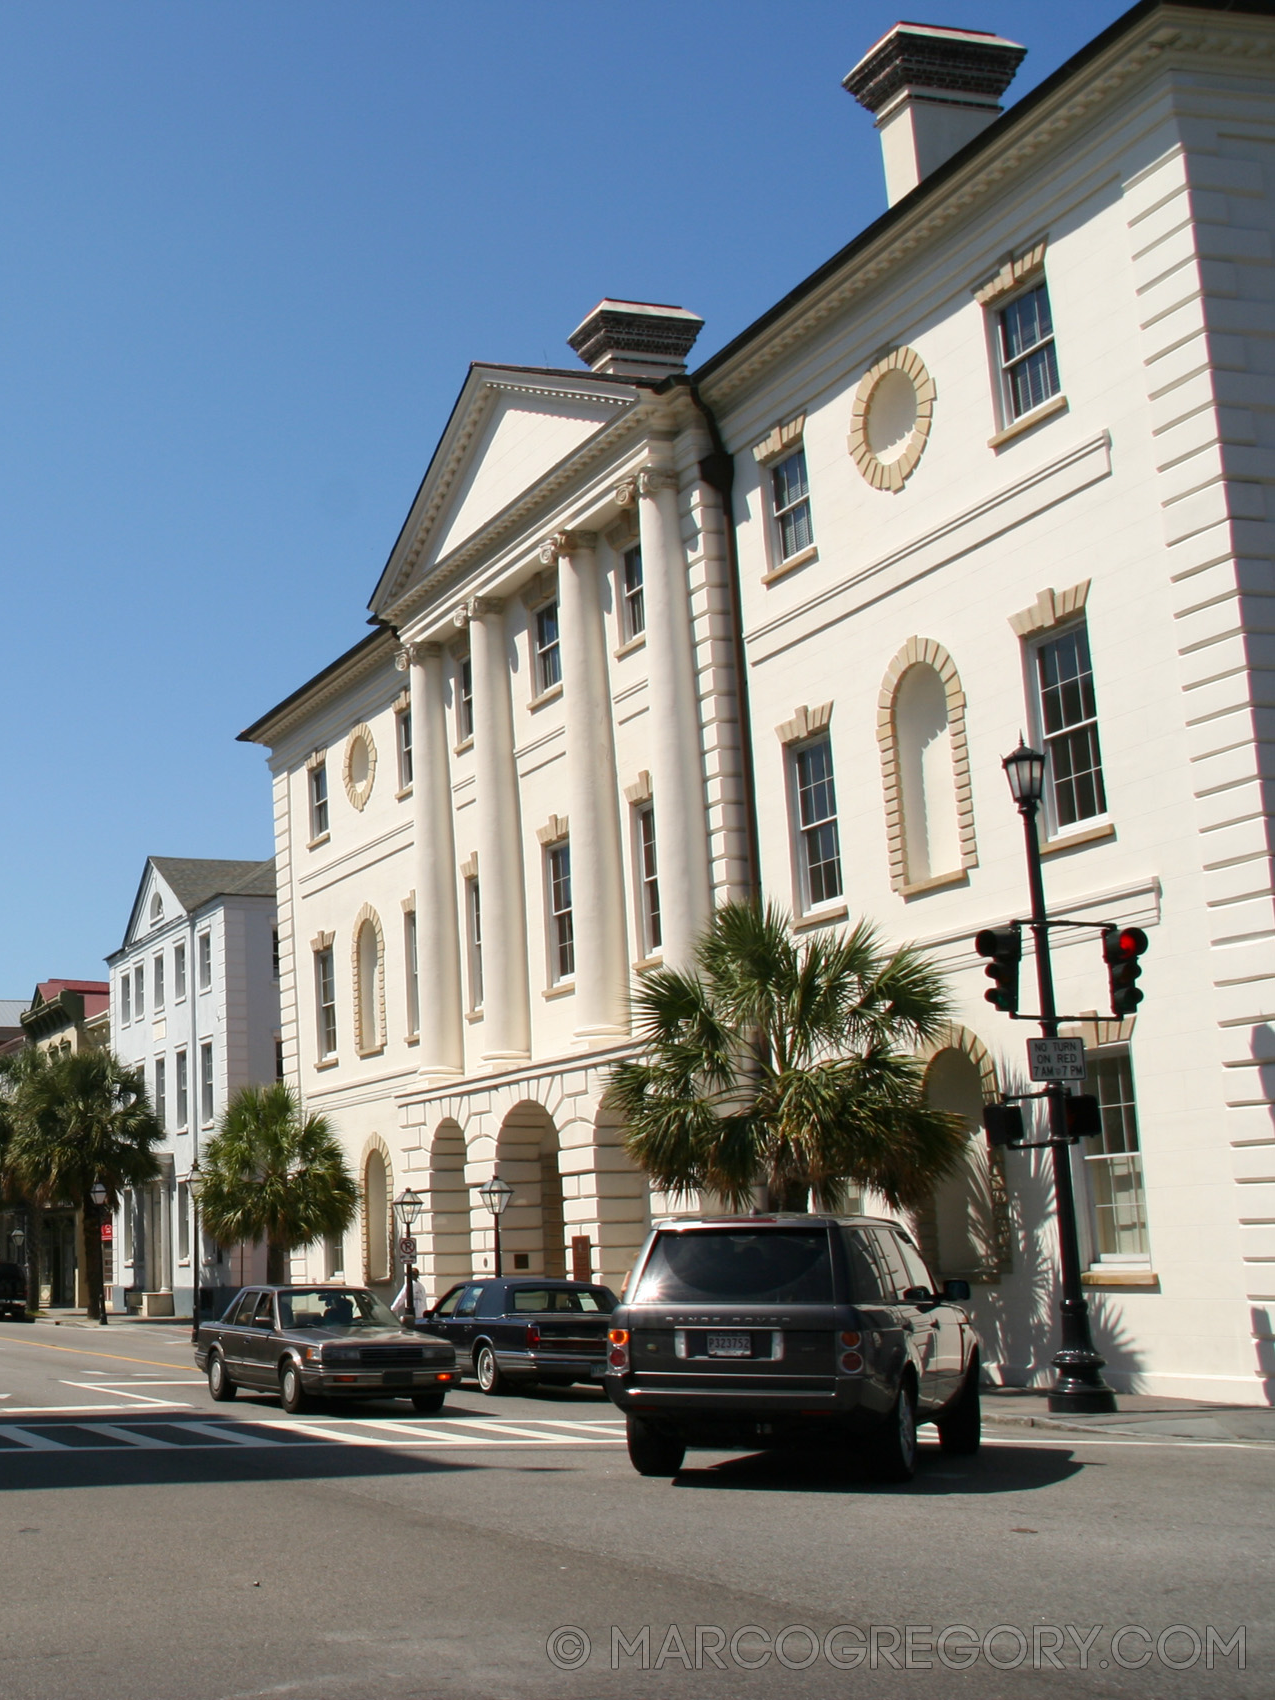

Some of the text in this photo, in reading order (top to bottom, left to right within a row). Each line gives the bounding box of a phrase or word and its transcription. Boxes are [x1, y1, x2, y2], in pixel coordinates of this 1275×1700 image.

[1034, 1041, 1076, 1052] NO TURN
[1037, 1053, 1077, 1064] ON RED
[1033, 1065, 1039, 1077] 7
[1041, 1065, 1054, 1077] AM
[1062, 1065, 1068, 1076] 7
[1070, 1065, 1083, 1076] PM
